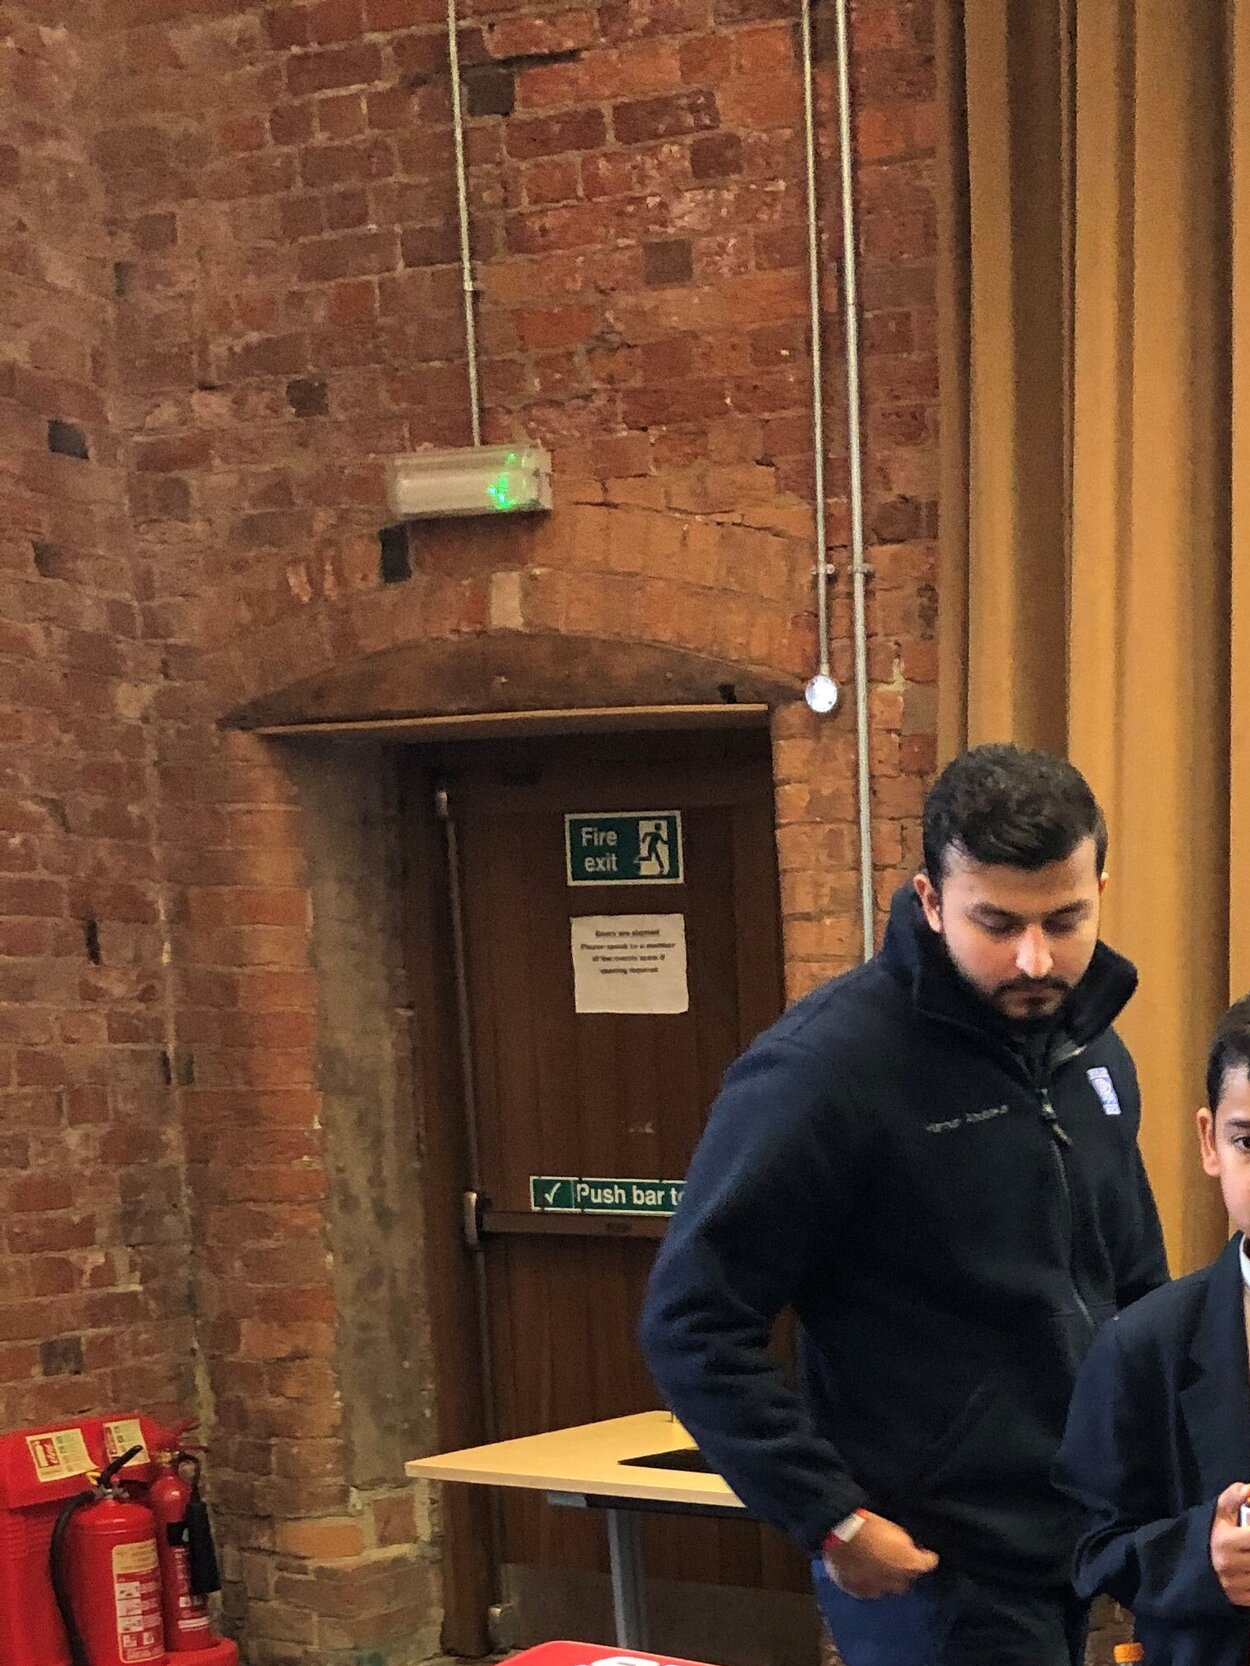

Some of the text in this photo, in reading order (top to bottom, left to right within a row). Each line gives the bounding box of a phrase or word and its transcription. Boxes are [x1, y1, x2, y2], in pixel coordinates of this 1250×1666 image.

[581, 826, 618, 847] Fire
[584, 852, 618, 873] exit
[576, 1183, 626, 1204] Push
[632, 1185, 665, 1206] bar
